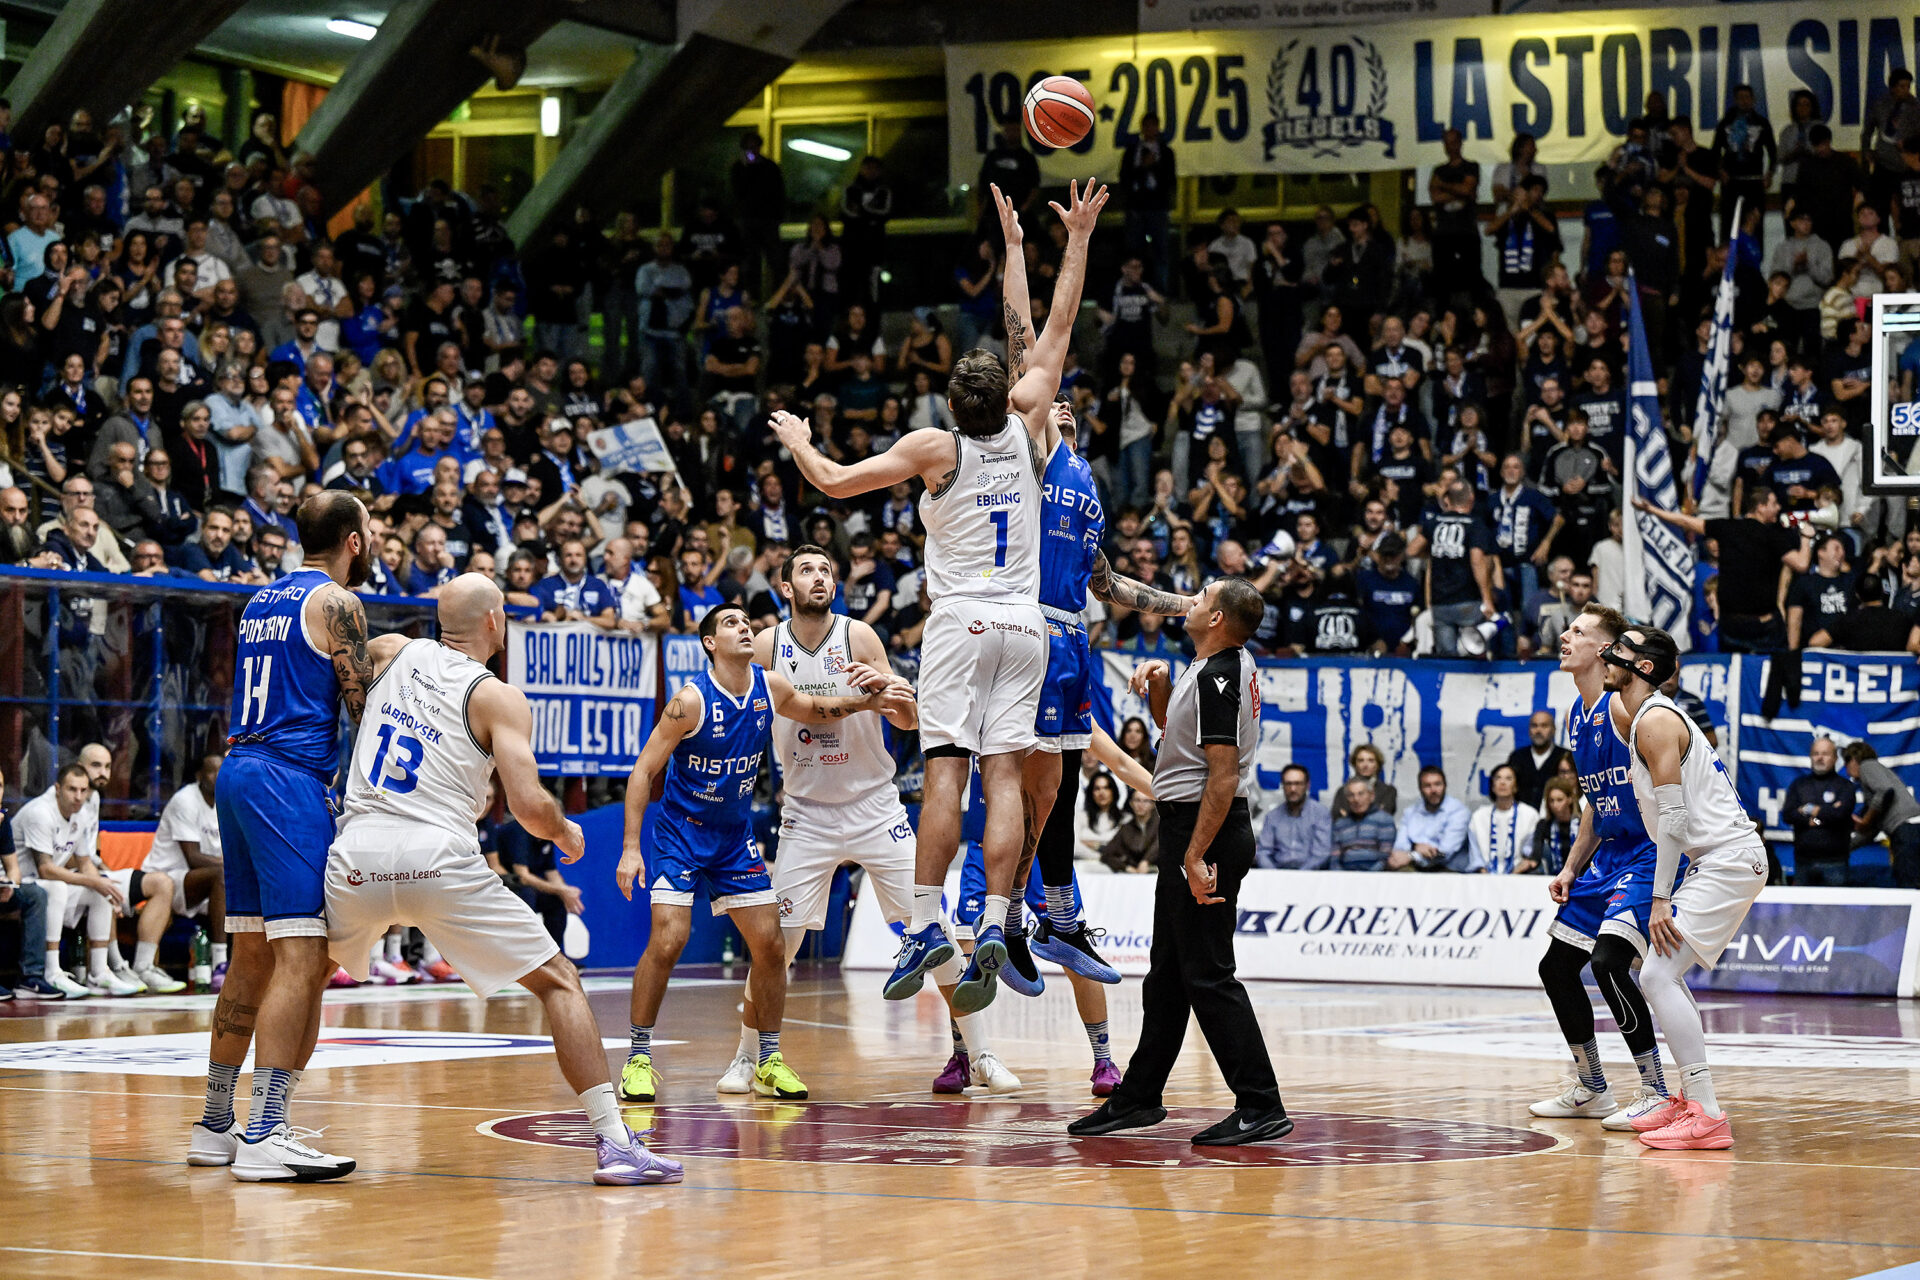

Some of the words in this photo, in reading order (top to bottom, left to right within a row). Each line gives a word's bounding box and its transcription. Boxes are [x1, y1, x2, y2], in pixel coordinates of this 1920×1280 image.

[1296, 44, 1357, 117] 40
[1413, 38, 1494, 143] LA
[1510, 23, 1768, 140] STORIA
[1109, 54, 1250, 150] 2025
[1274, 114, 1382, 142] REBELS
[992, 471, 1020, 482] HVM
[976, 491, 1021, 507] EBELING
[989, 510, 1009, 568] 1
[525, 630, 643, 690] BALAUSTRA
[780, 644, 793, 658] 18
[413, 695, 441, 716] HVM
[712, 701, 725, 723] 6
[528, 698, 642, 757] MOLESTA
[367, 722, 424, 795] 13
[692, 790, 725, 803] FABRIANO
[745, 839, 758, 859] 6
[369, 871, 411, 883] Toscana
[412, 869, 442, 880] Legno
[1275, 903, 1544, 939] LORENZONI
[1299, 941, 1396, 957] CANTIERE
[1403, 942, 1483, 960] NAVALE
